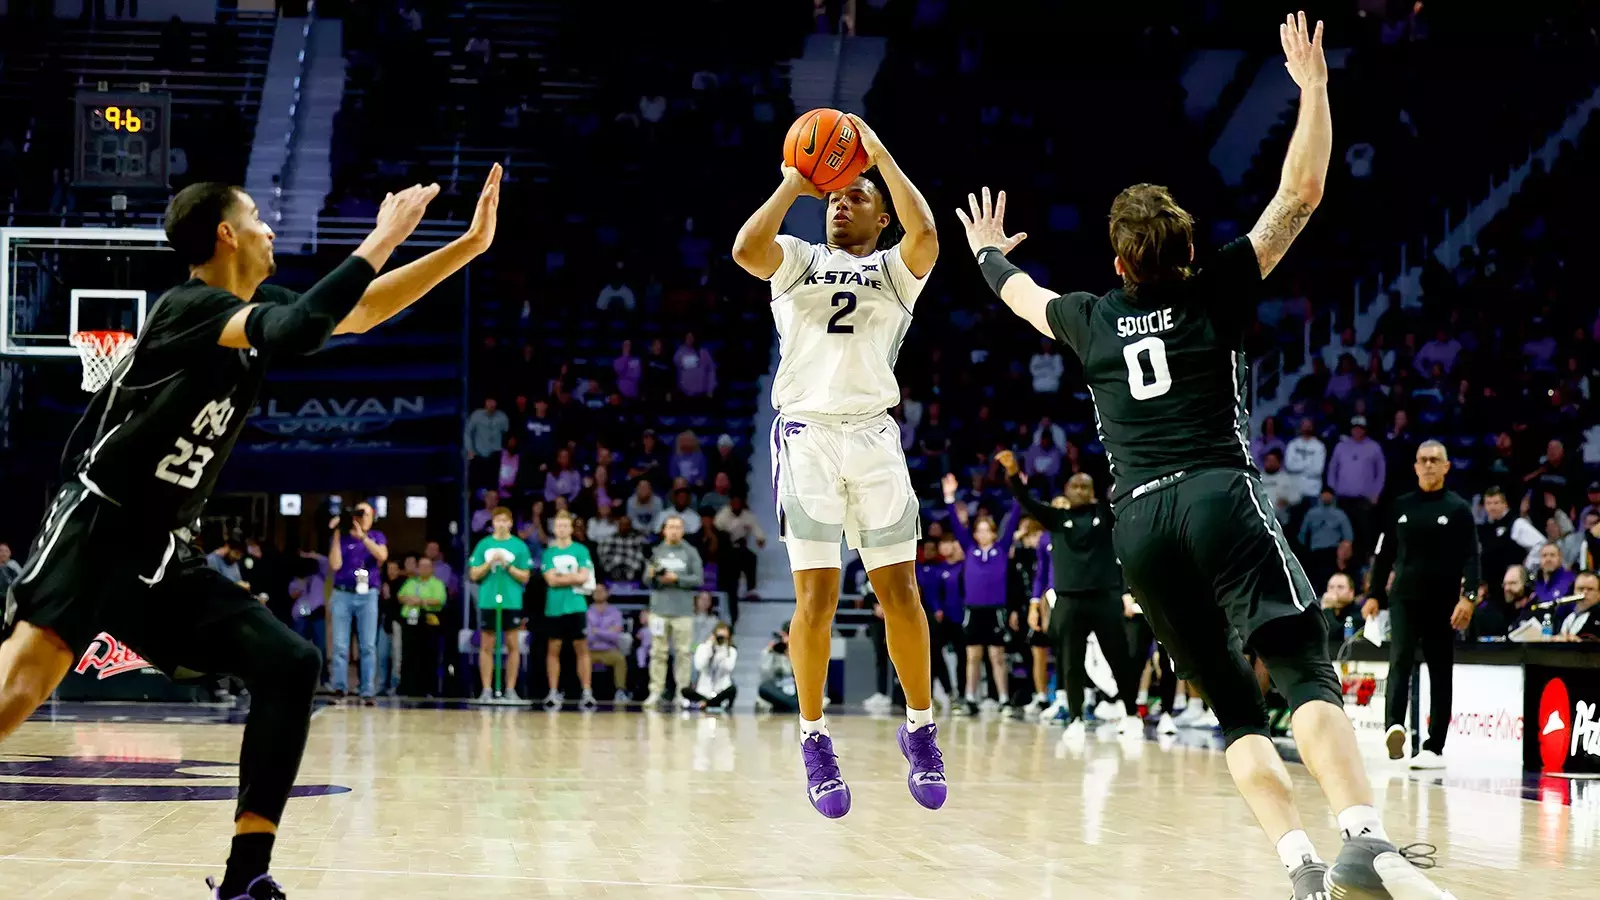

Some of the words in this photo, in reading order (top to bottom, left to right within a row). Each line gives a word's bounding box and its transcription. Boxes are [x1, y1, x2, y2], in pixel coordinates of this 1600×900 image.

[105, 106, 141, 132] 9.6
[825, 126, 854, 169] ELITE
[803, 270, 882, 290] K-STATE
[826, 291, 857, 334] 2
[1116, 307, 1174, 338] SOUCIE
[1122, 336, 1172, 401] 0
[154, 436, 215, 489] 23
[1449, 712, 1494, 738] MOOTHIE
[1570, 699, 1600, 757] Piz
